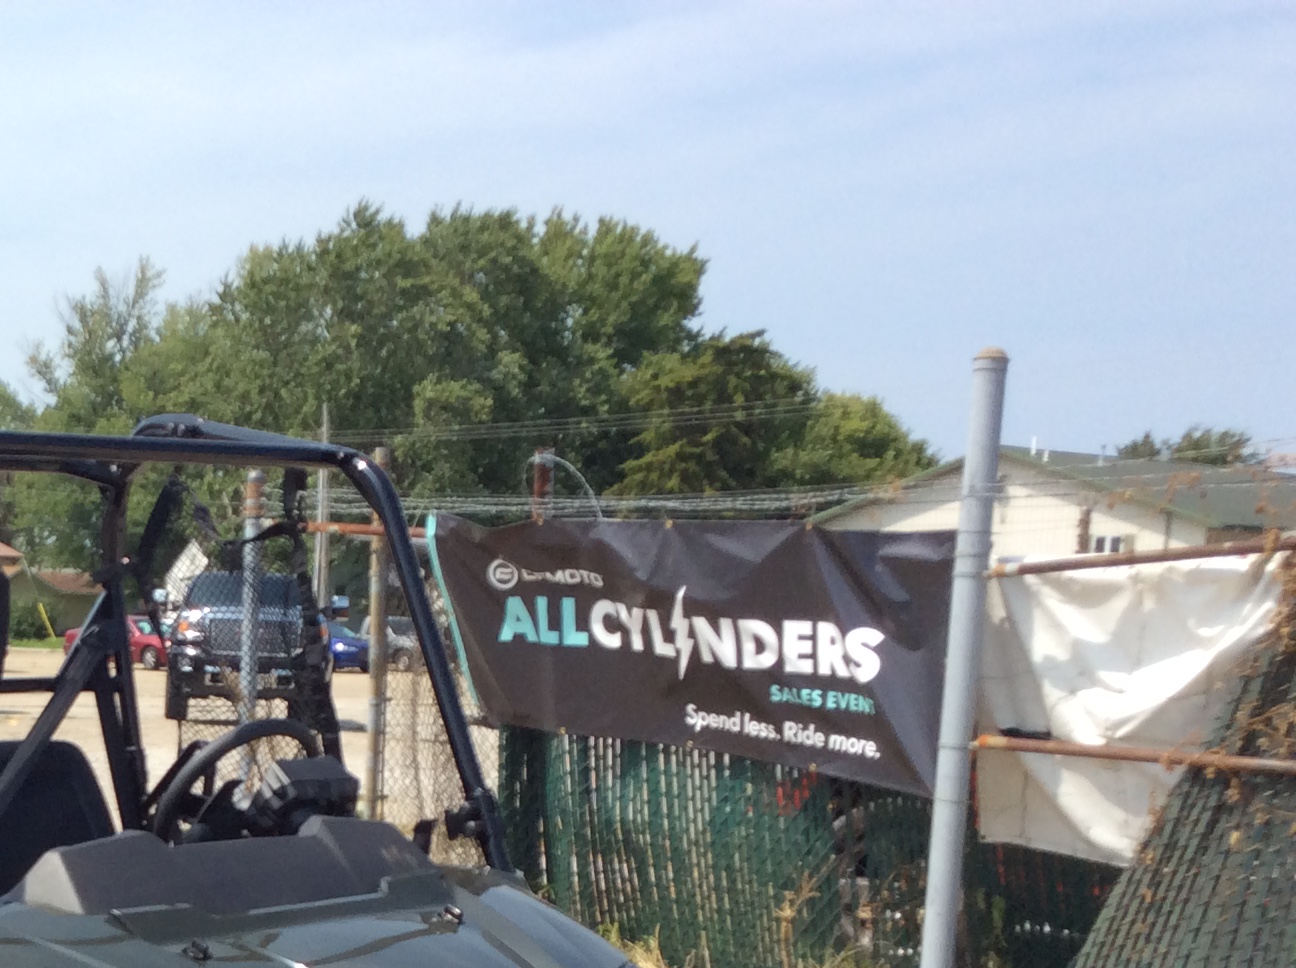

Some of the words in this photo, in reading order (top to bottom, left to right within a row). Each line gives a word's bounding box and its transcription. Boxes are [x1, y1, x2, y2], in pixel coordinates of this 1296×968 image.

[769, 684, 822, 708] SALES
[825, 690, 876, 715] EVENT
[685, 703, 741, 732] Spend
[743, 712, 781, 740] less.
[783, 720, 825, 747] Ride
[828, 733, 881, 759] more.
